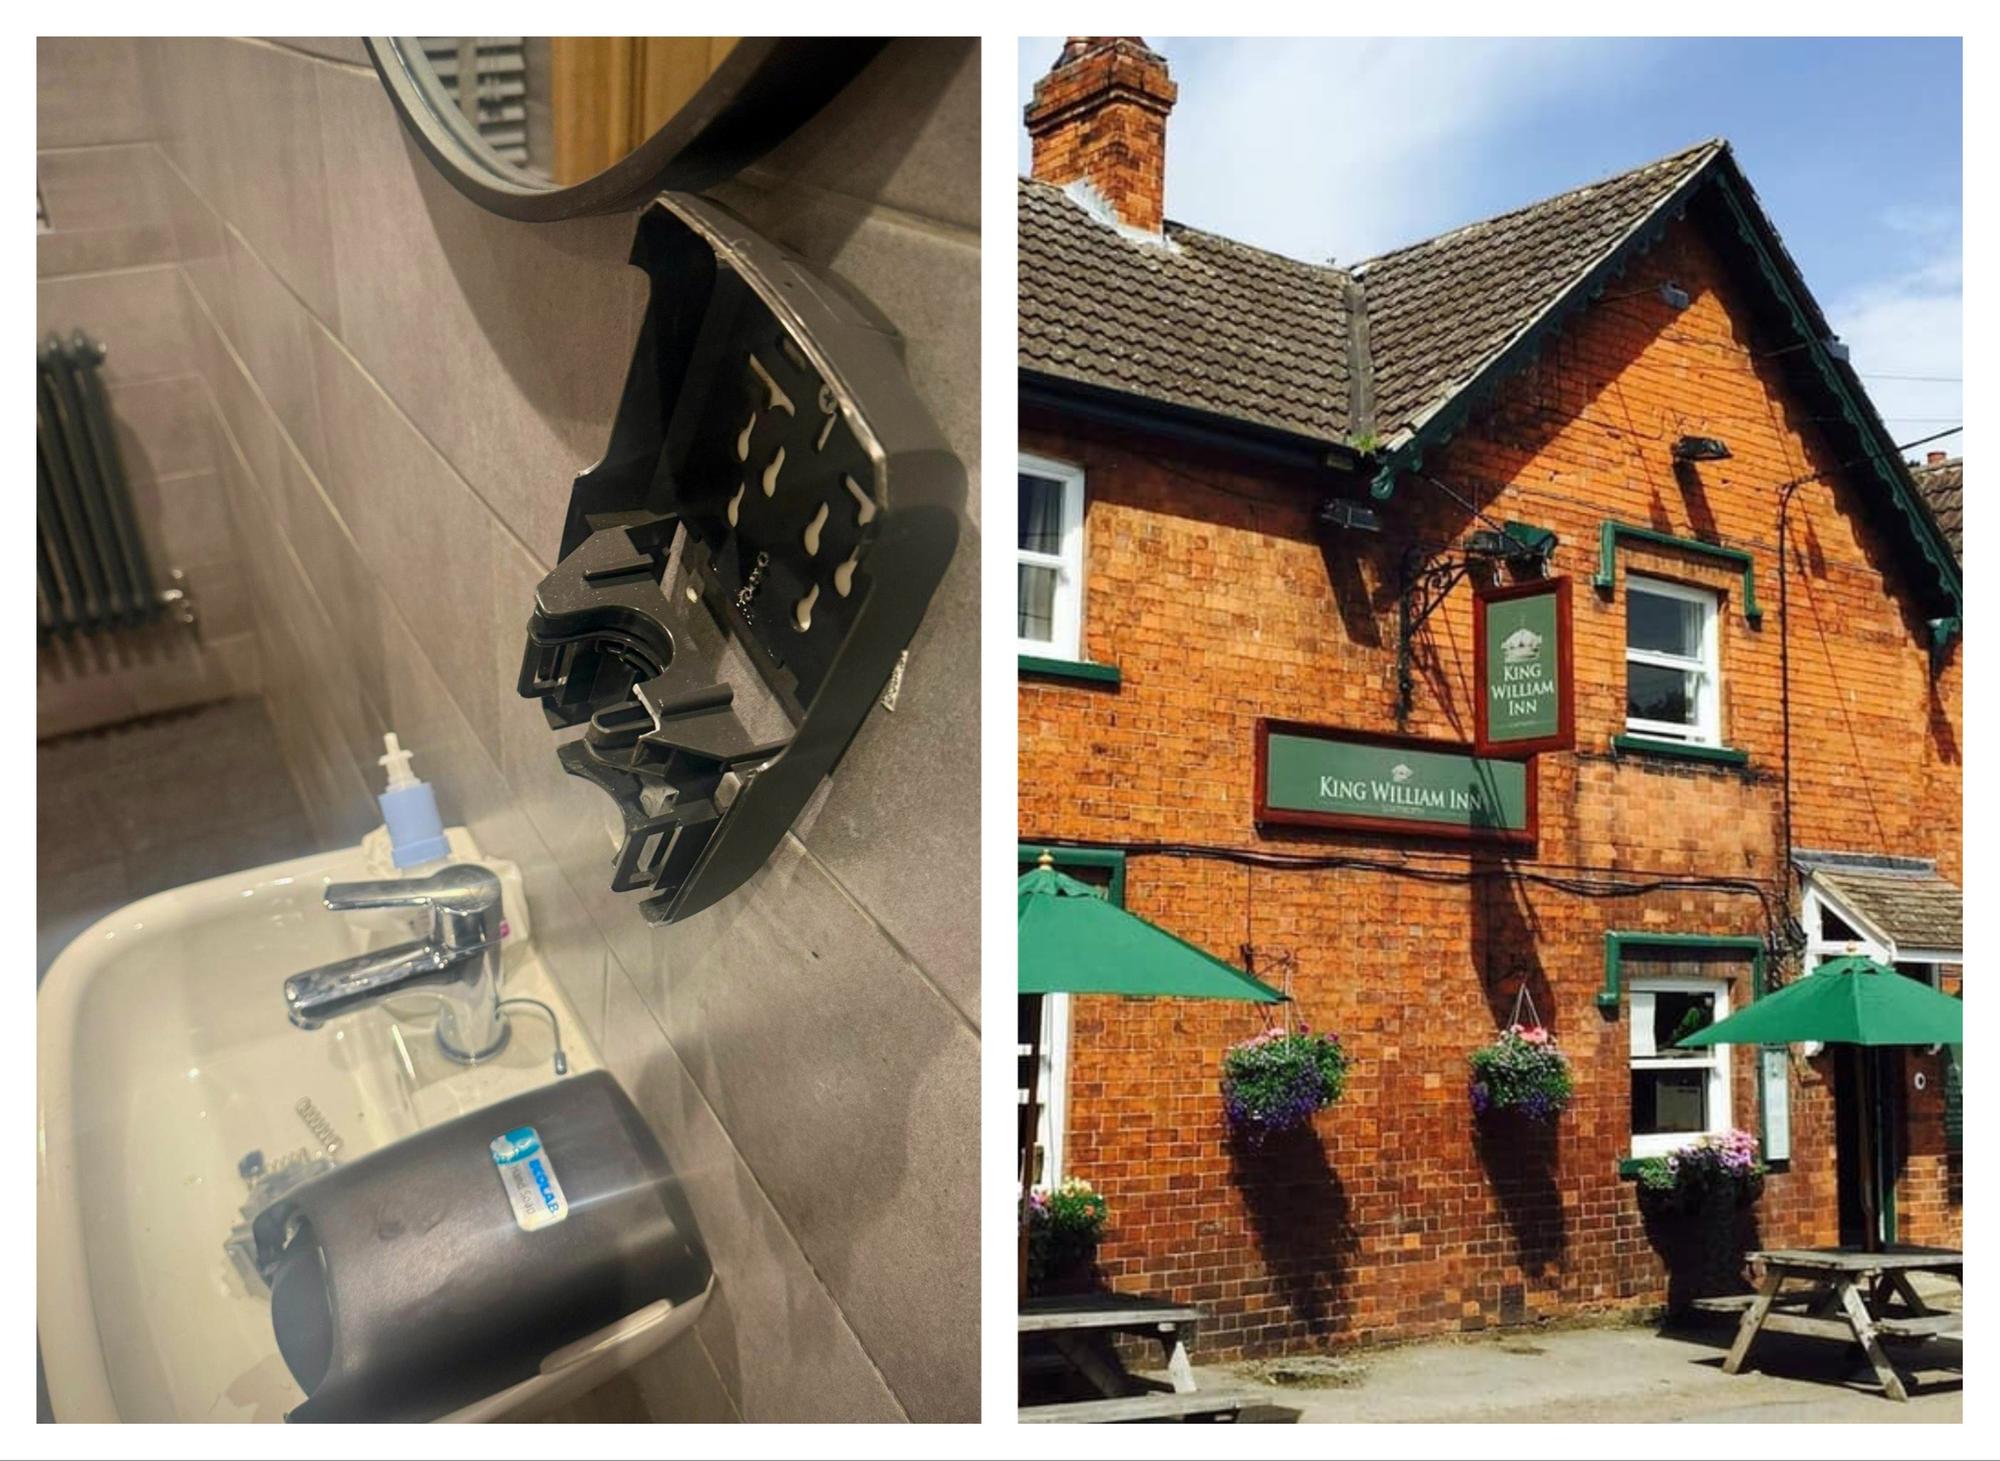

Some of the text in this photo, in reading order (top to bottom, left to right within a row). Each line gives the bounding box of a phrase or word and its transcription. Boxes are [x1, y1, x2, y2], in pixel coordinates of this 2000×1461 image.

[1503, 663, 1542, 682] KING
[1491, 680, 1554, 700] WILLIAM
[1509, 700, 1537, 716] INN
[1320, 775, 1367, 801] KING
[1371, 780, 1445, 808] WILLIAM
[1450, 789, 1484, 811] INN
[528, 1158, 559, 1215] ECOLAB
